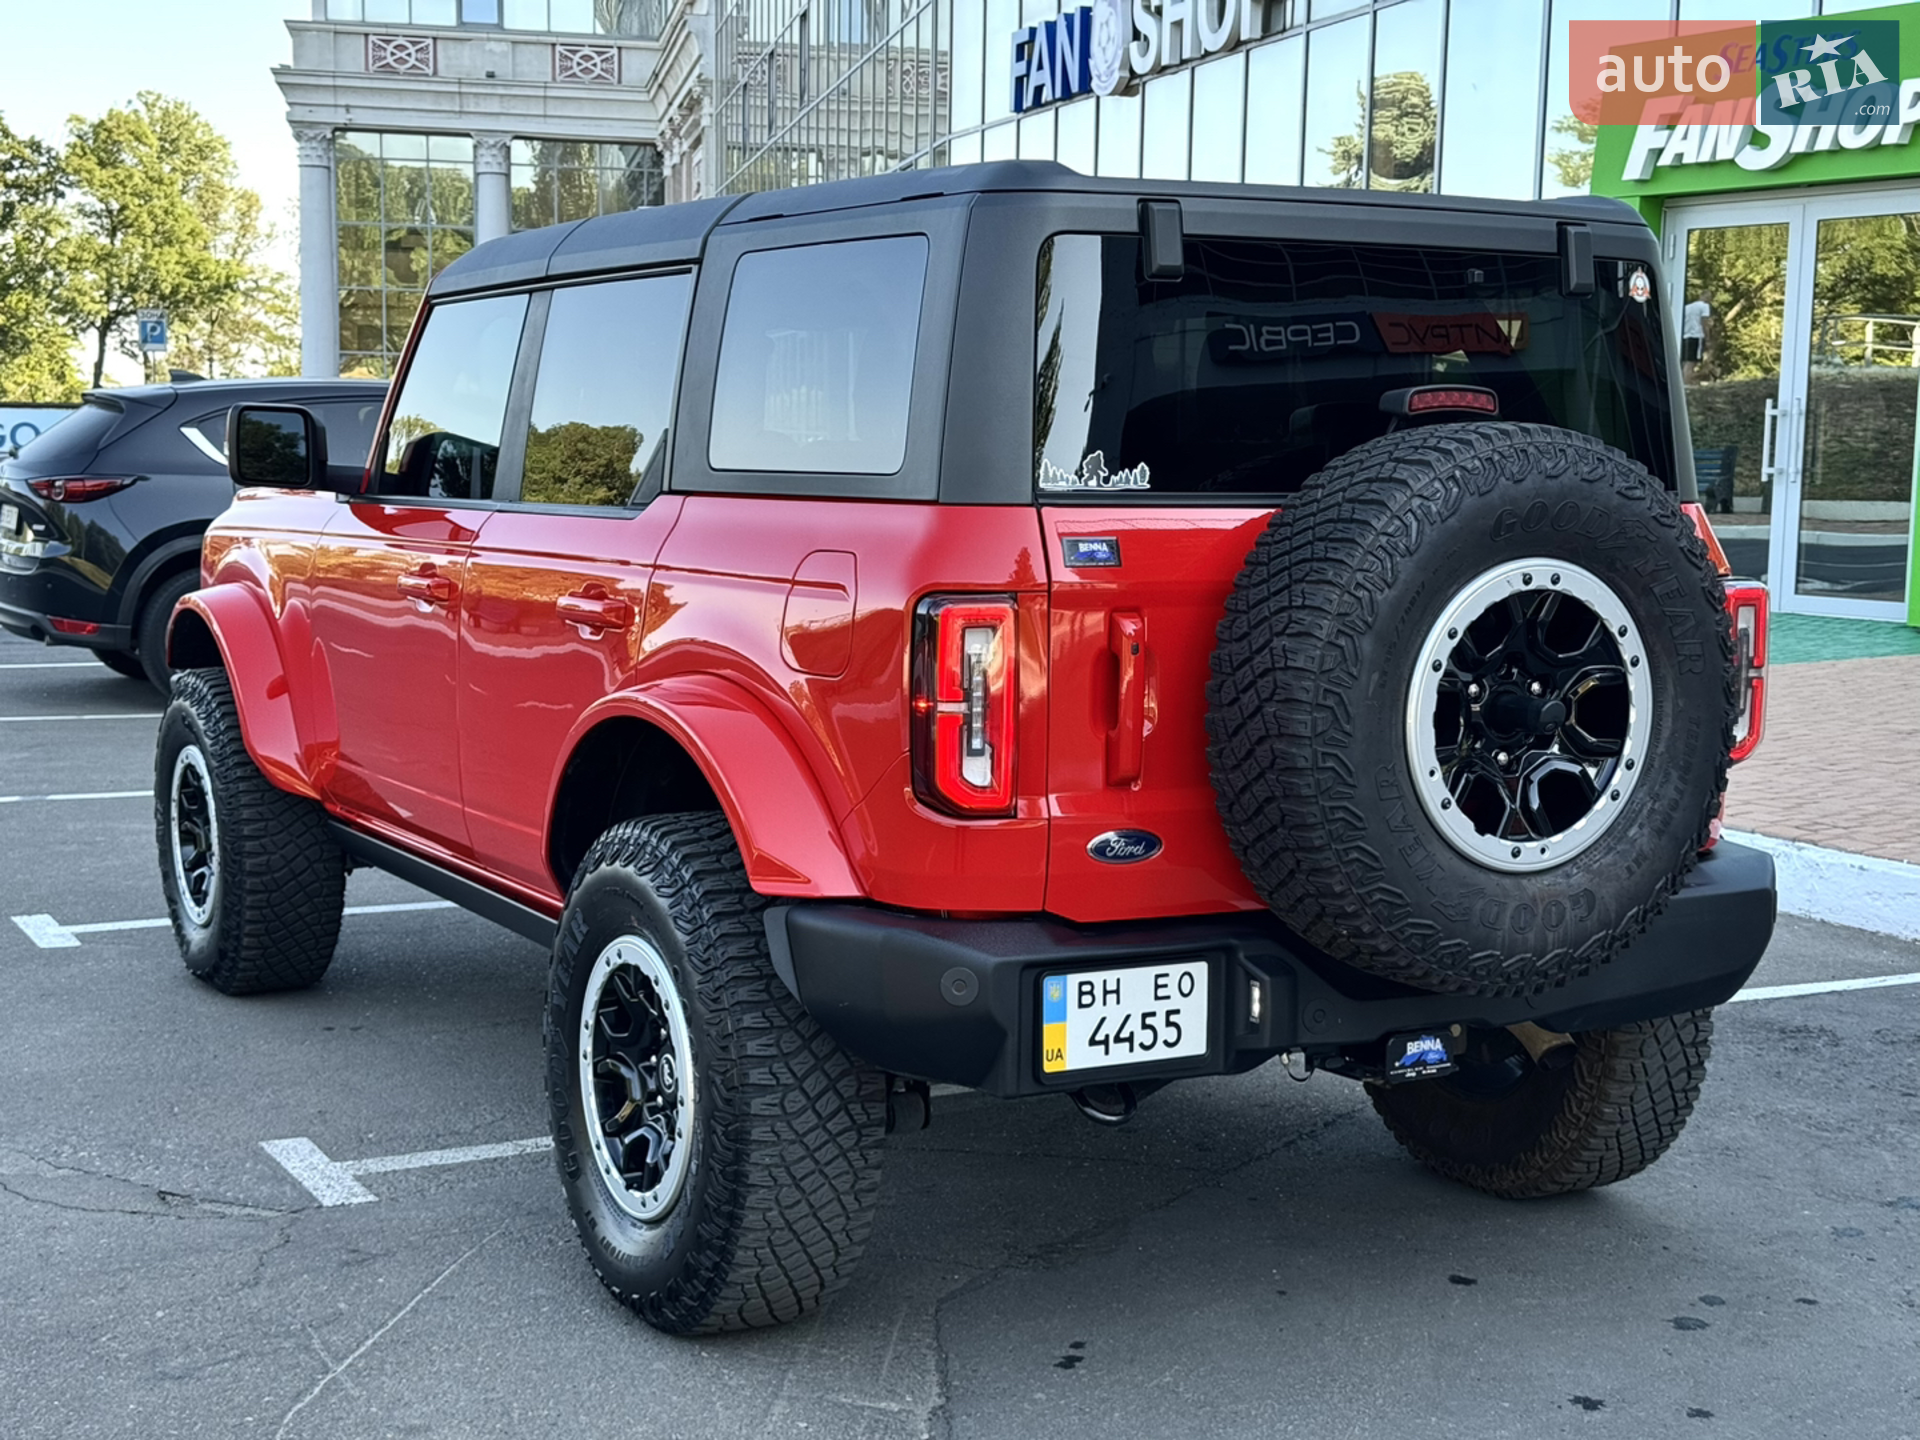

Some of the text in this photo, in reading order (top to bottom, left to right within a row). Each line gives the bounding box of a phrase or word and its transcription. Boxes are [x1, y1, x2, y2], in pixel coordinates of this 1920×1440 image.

[1010, 6, 1093, 112] FAN
[1106, 837, 1146, 856] Ford
[1078, 977, 1120, 1009] BH
[1088, 1008, 1182, 1056] 4455
[1046, 1048, 1064, 1062] UA
[1407, 1038, 1442, 1055] BENNA
